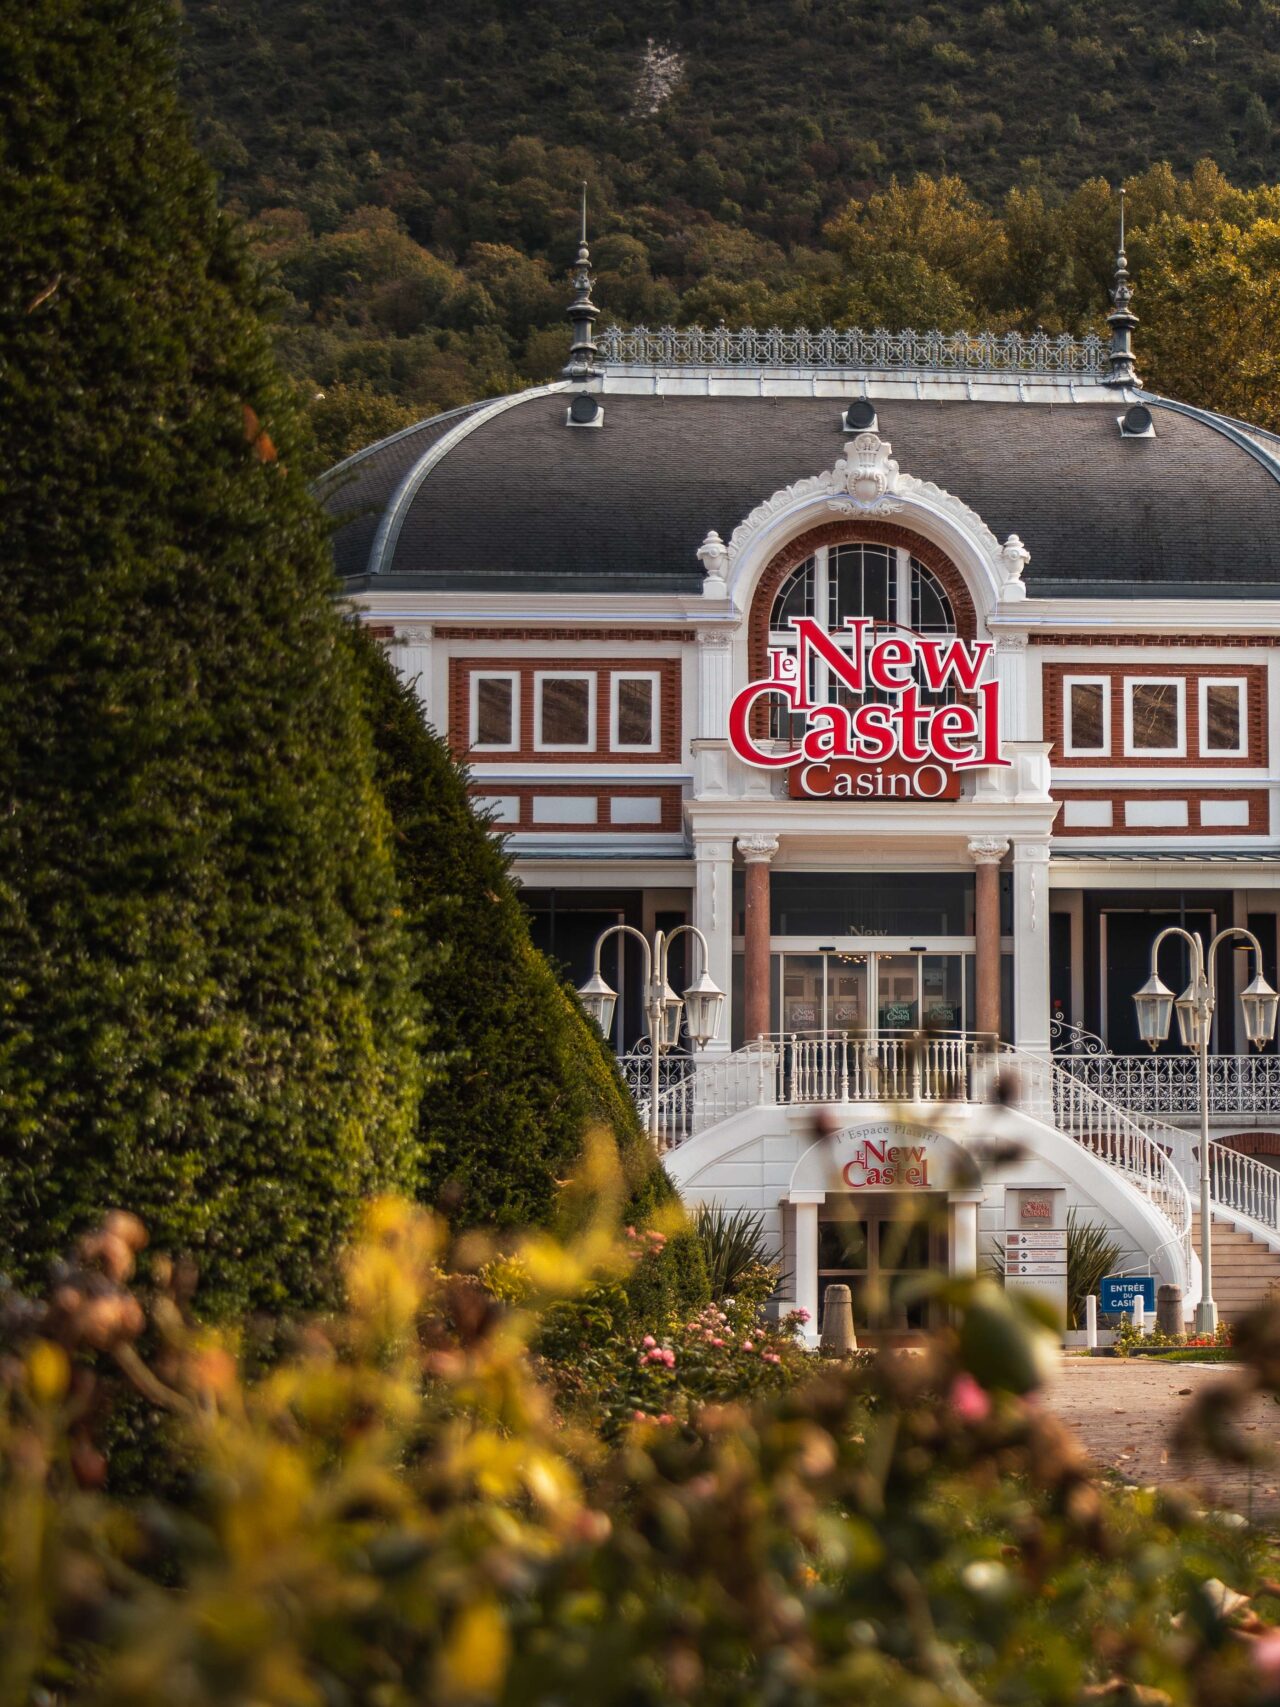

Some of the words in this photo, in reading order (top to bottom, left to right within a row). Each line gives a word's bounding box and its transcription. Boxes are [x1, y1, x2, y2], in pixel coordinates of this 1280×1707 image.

[769, 649, 797, 681] Le
[789, 617, 995, 712] New
[728, 680, 1011, 770] Castel
[856, 1150, 865, 1161] Le
[862, 1140, 926, 1170] New
[1110, 1283, 1145, 1293] ENTRÉE
